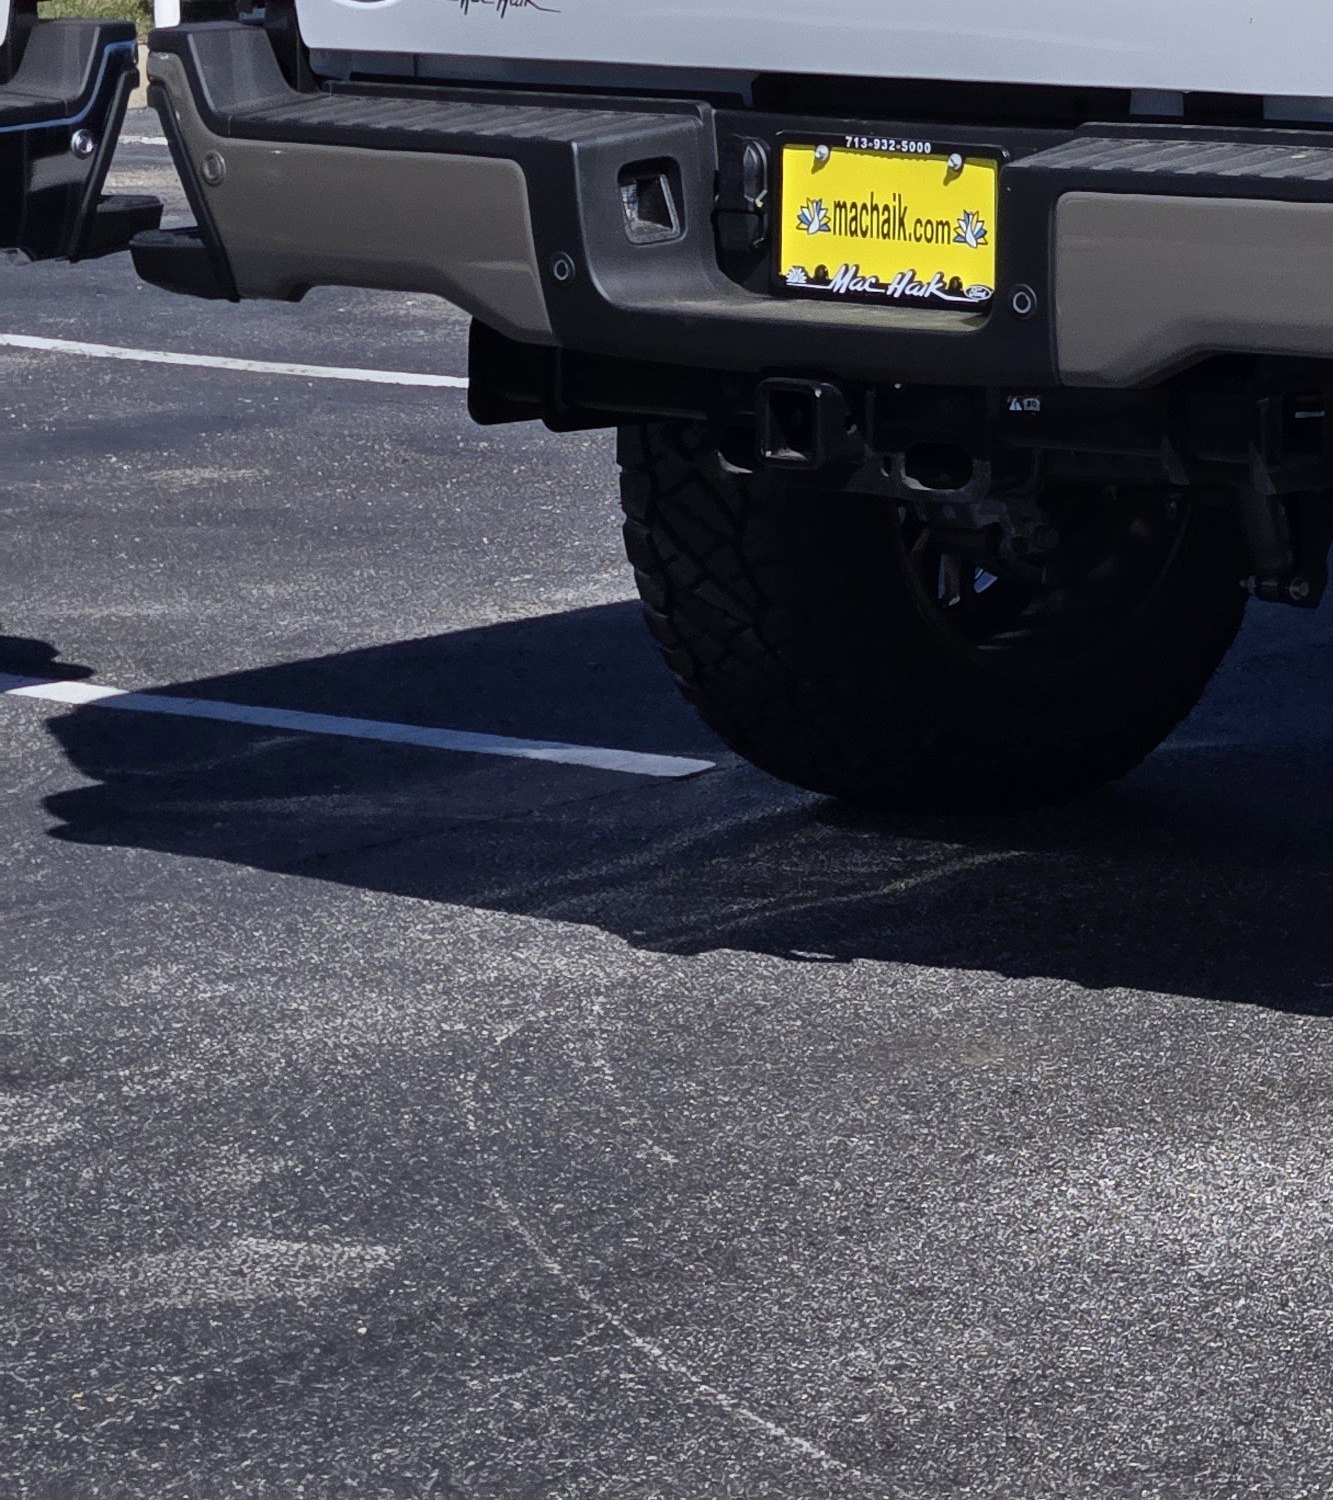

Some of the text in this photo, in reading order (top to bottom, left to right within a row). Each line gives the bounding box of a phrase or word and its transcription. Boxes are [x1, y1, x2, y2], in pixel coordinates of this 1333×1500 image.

[832, 191, 951, 245] machaik.com
[829, 263, 948, 299] Mac Haik
